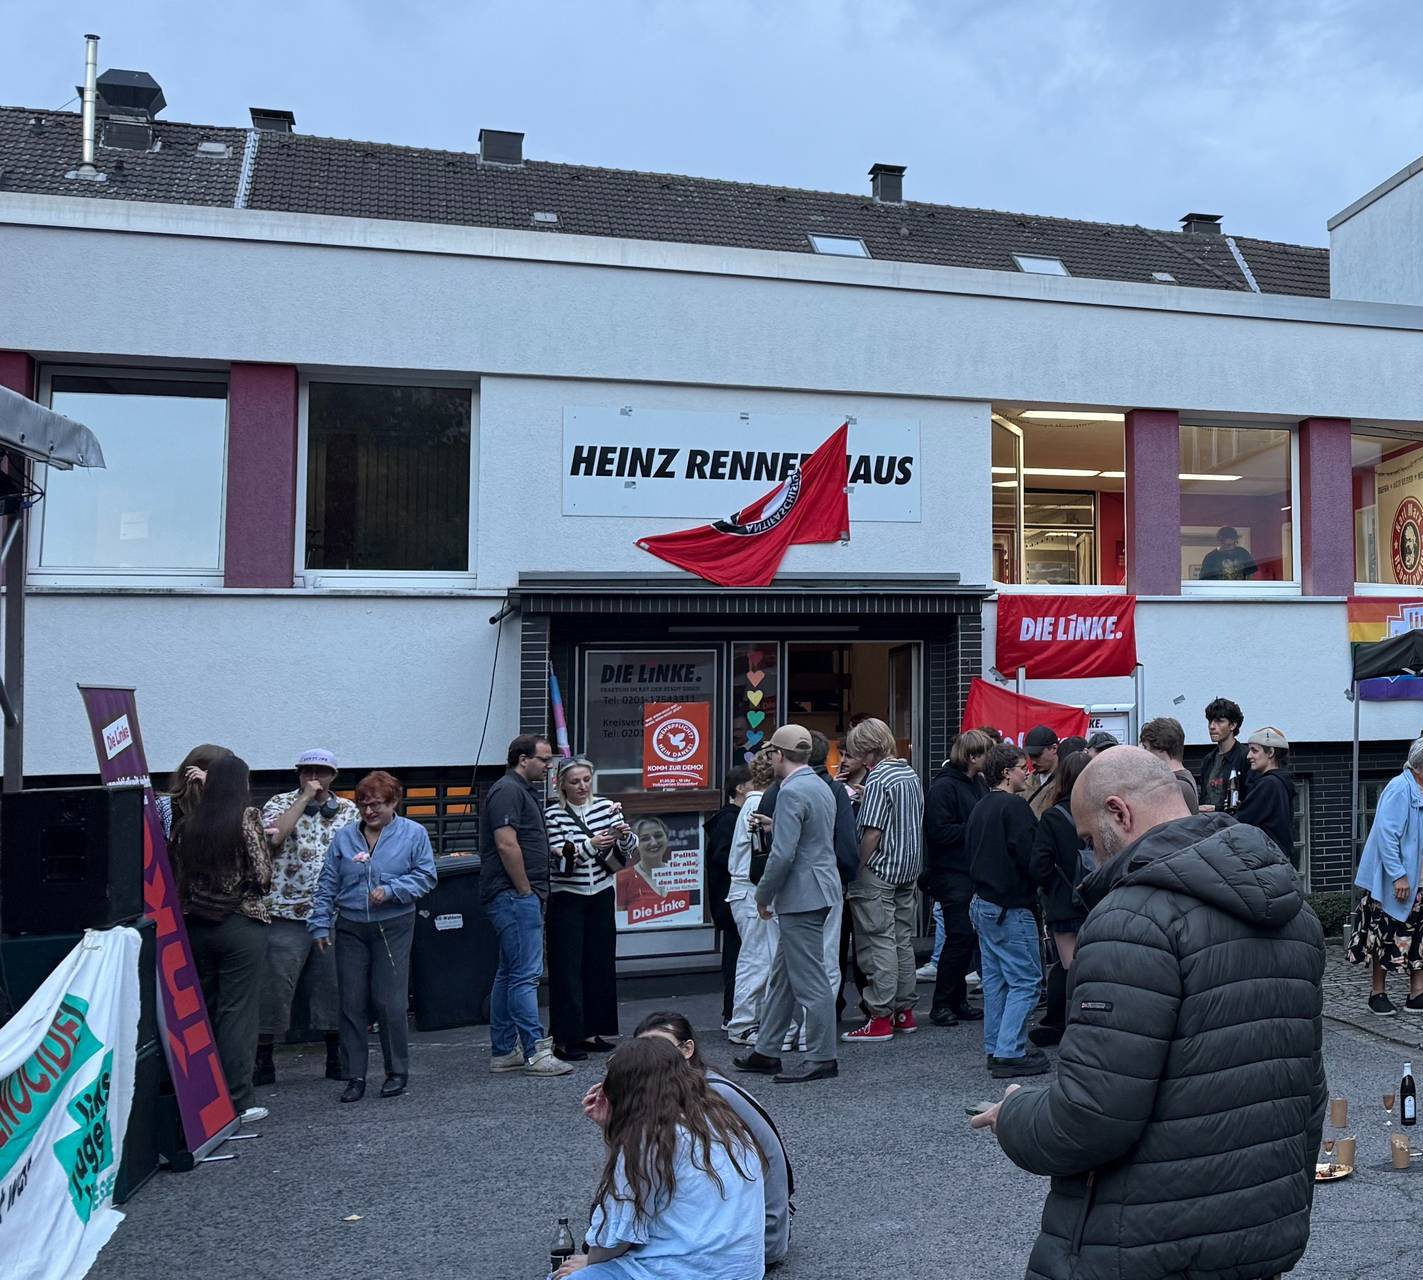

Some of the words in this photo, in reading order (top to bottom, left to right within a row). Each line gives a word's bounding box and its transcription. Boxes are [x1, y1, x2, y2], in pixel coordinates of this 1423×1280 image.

[570, 446, 680, 478] HEINZ
[1019, 617, 1055, 641] DIE
[600, 664, 634, 684] DIE
[632, 905, 652, 920] Die
[653, 897, 686, 915] Linke
